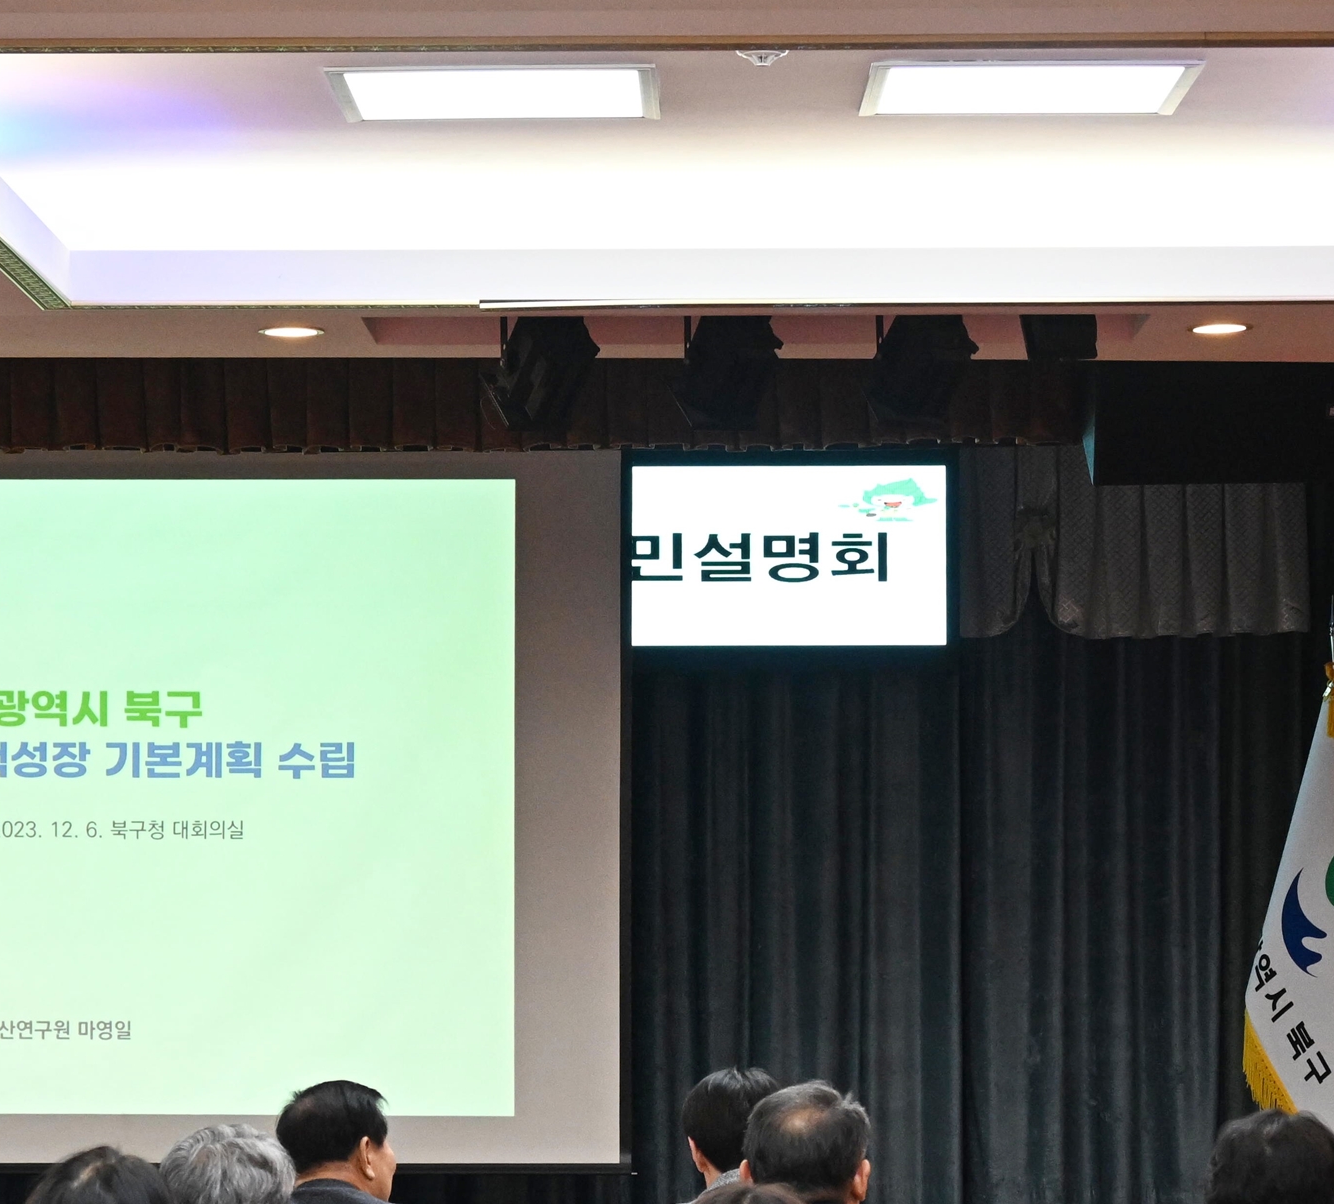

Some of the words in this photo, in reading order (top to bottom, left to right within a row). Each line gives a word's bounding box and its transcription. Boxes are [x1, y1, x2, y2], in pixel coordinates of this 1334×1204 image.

[632, 531, 888, 583] 민설명회
[123, 690, 203, 729] 북구
[105, 740, 262, 779] 기본계획
[277, 741, 355, 780] 수립
[51, 820, 79, 839] 12.
[85, 820, 103, 839] 6.
[110, 819, 165, 841] 북구청
[172, 819, 244, 840] 대회의실
[77, 1020, 132, 1041] 마영일
[1255, 941, 1295, 1023] 역시
[1286, 1020, 1332, 1084] 북구
